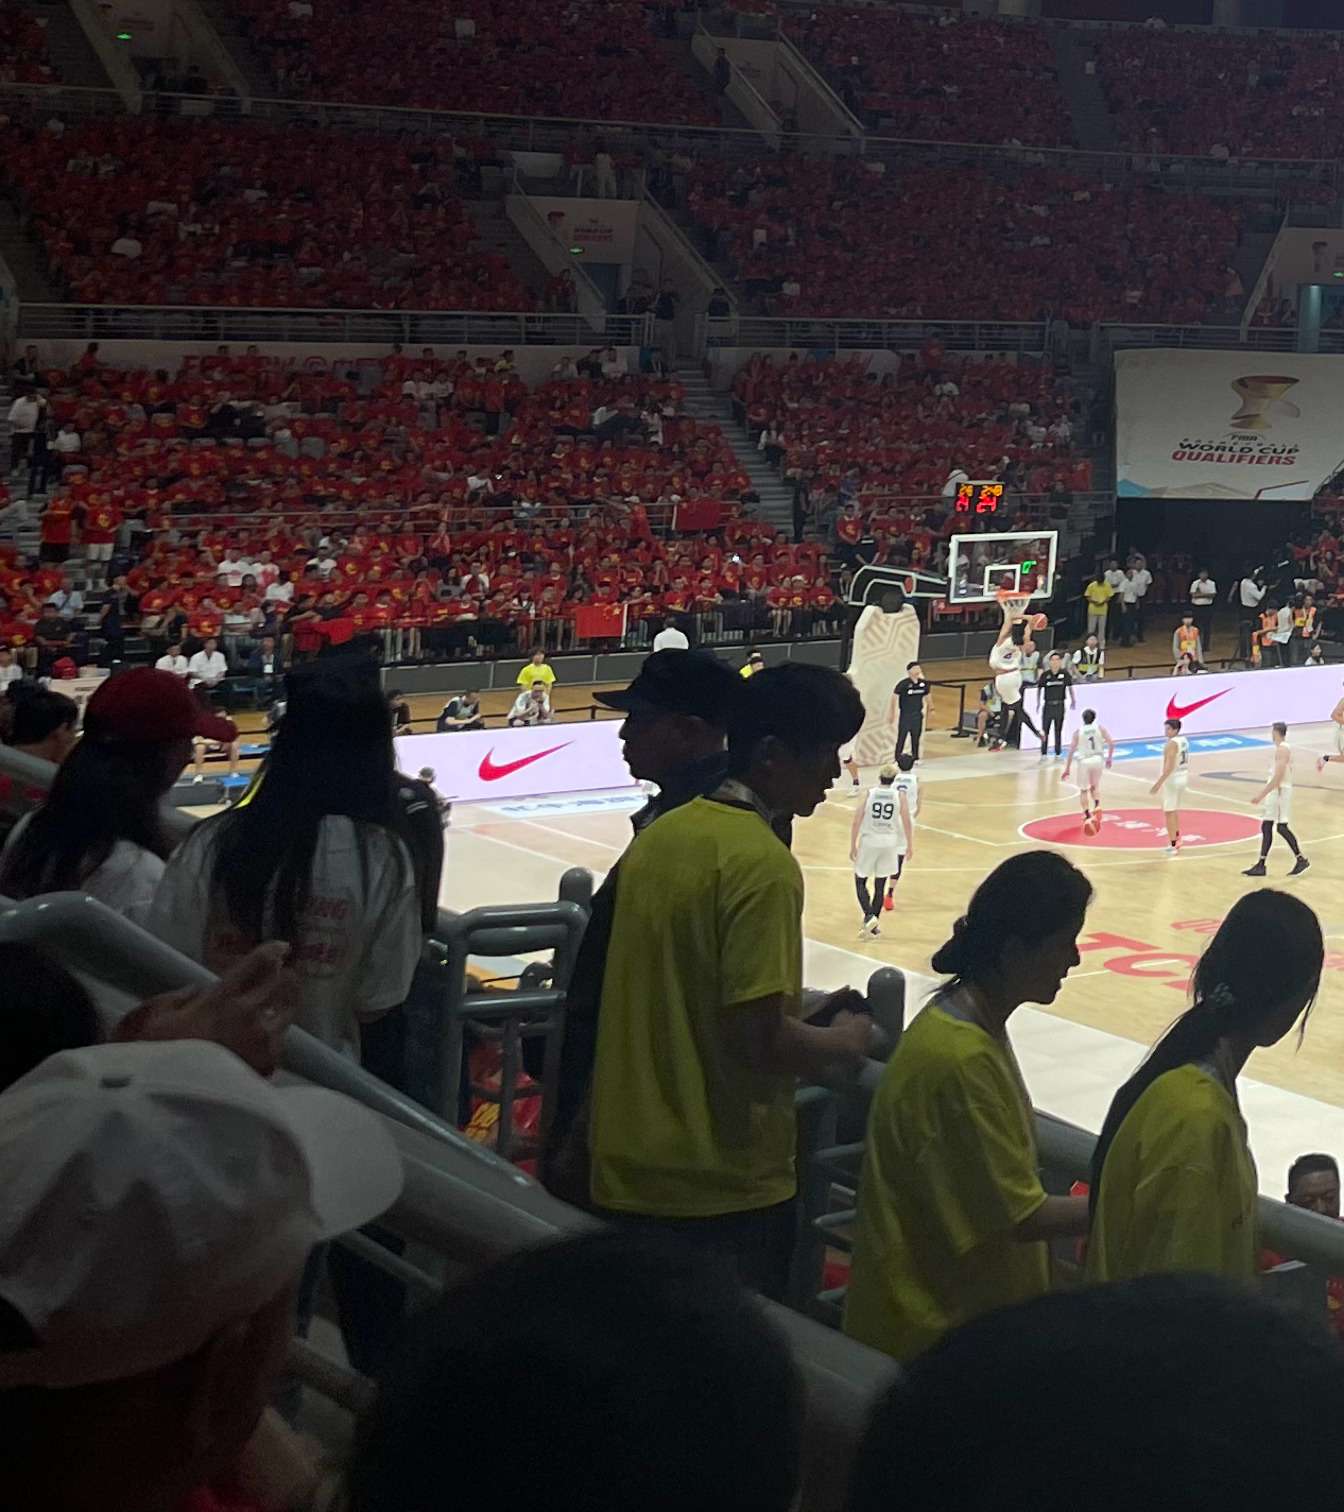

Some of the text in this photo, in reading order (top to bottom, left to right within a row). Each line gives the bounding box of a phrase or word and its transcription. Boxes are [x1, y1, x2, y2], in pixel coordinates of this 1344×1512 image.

[1178, 443, 1301, 456] WORLD CUP
[1171, 450, 1297, 467] QUALIFIERS
[872, 802, 894, 819] 99
